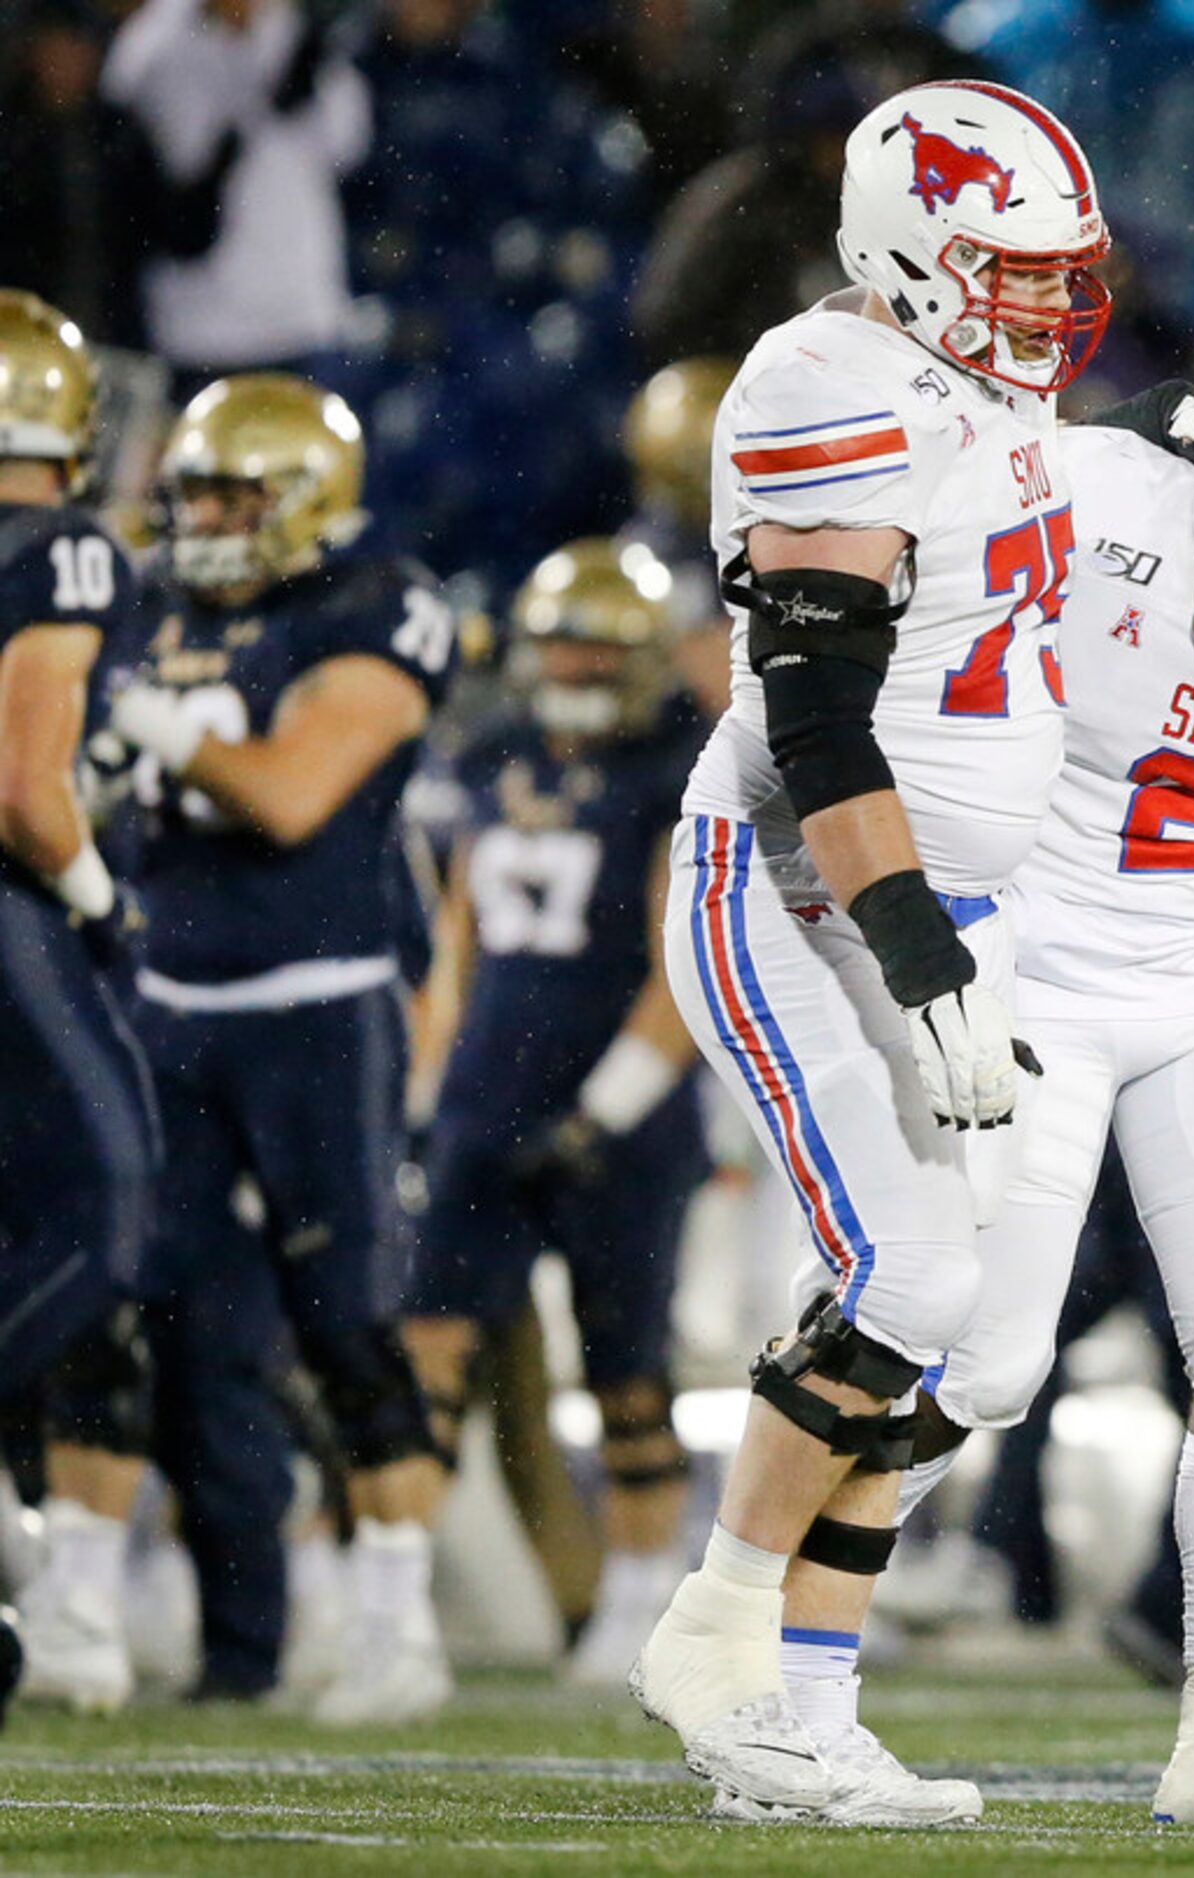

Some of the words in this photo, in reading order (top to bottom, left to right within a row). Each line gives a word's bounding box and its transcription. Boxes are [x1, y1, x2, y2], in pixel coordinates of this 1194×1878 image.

[1010, 440, 1052, 509] SMU
[48, 535, 114, 611] 10
[1093, 538, 1162, 587] 150
[938, 500, 1077, 719] 75
